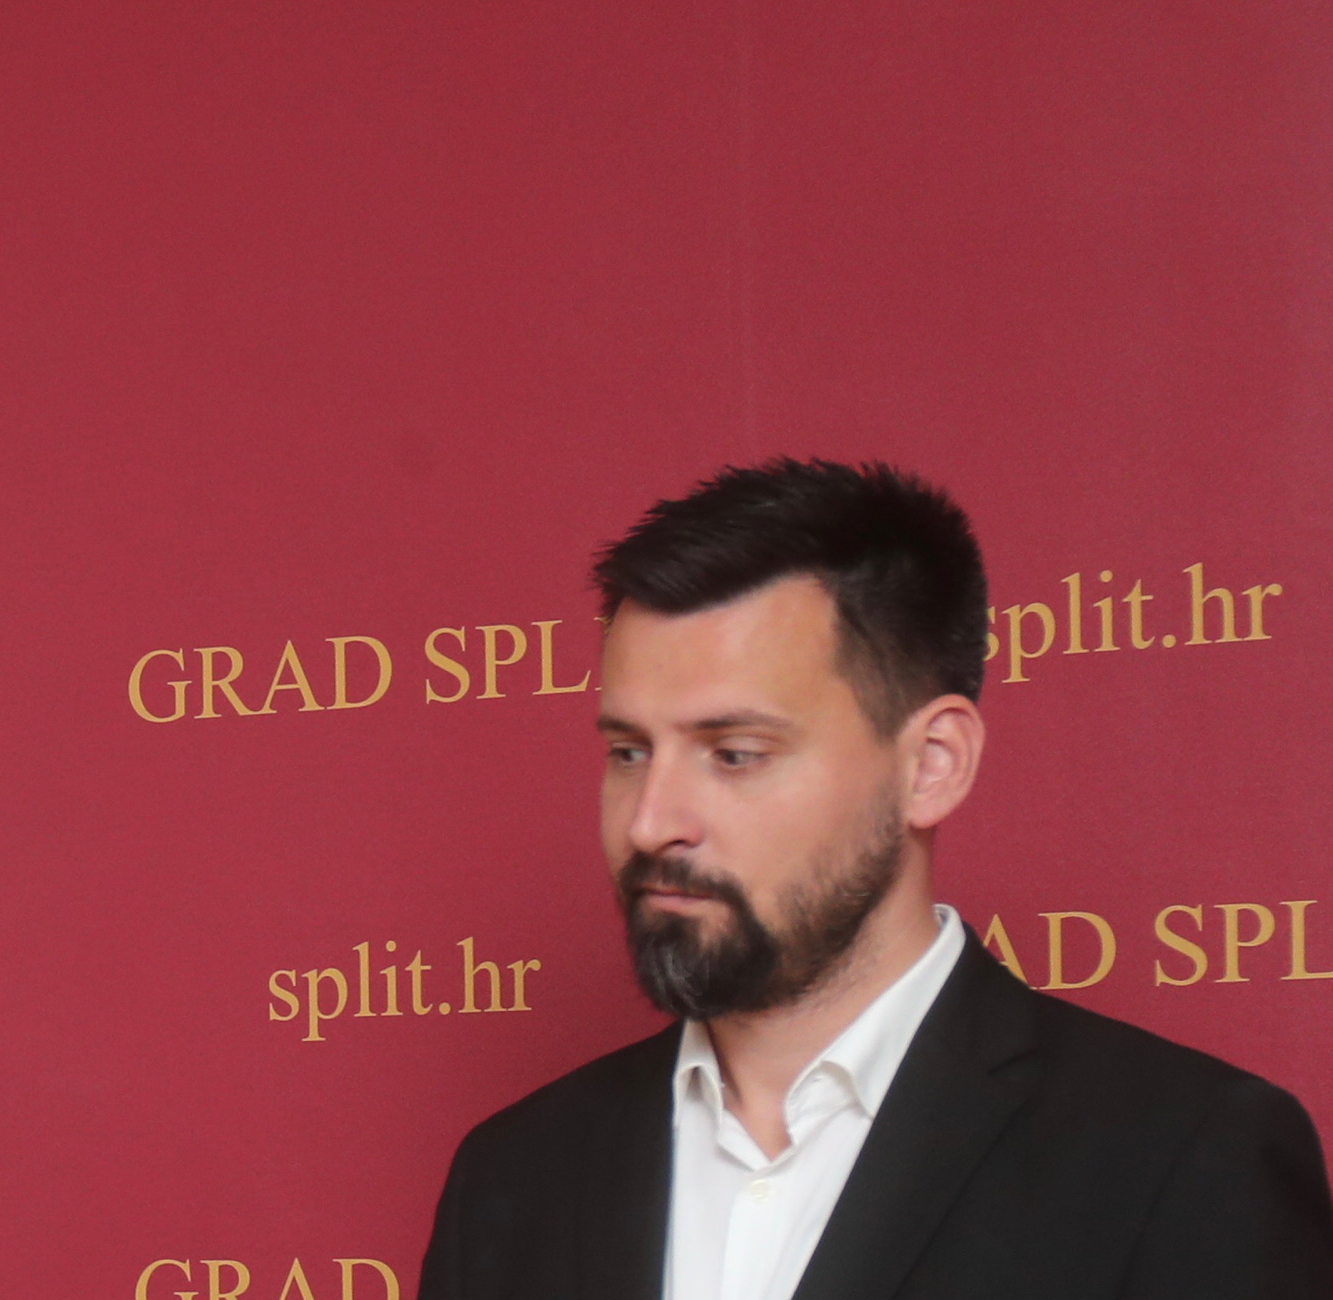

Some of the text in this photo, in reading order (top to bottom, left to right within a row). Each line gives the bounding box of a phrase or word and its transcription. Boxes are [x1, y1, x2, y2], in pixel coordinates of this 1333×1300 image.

[129, 616, 612, 723] GRAD SPL
[269, 937, 542, 1042] split.hr
[983, 910, 1117, 990] AD
